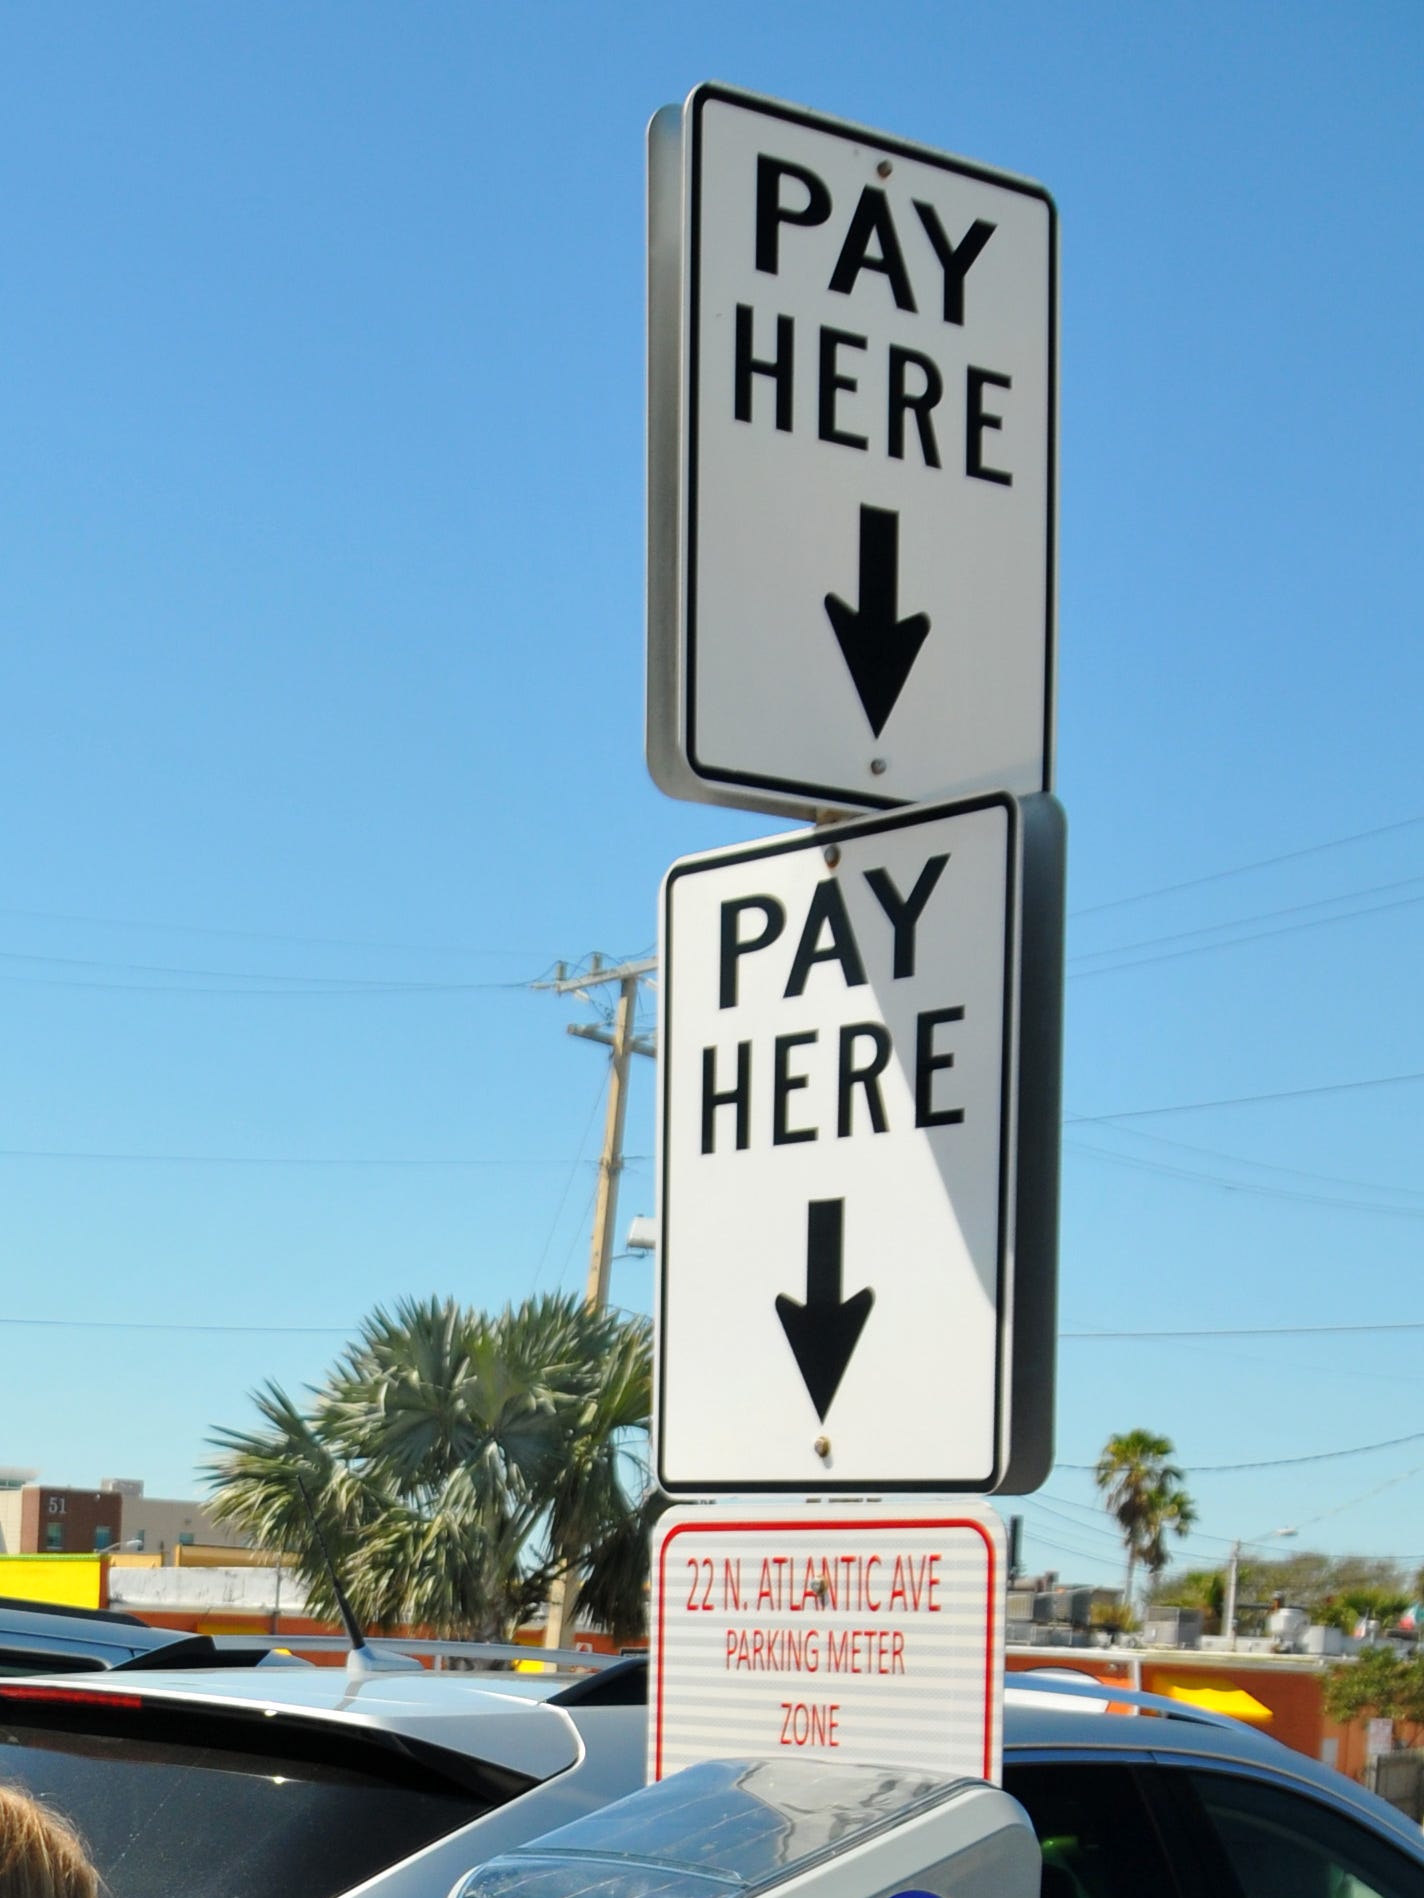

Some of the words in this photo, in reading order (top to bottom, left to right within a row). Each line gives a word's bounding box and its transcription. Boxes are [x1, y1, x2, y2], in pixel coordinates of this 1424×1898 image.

[755, 151, 998, 327] PAY
[733, 303, 1014, 487] HERE
[718, 852, 952, 1010] PAY
[700, 1004, 966, 1155] HERE
[48, 1496, 66, 1514] 51
[686, 1557, 715, 1612] 22
[724, 1557, 749, 1612] N.
[757, 1555, 883, 1612] ATLANTIC
[889, 1554, 943, 1613] AVE
[726, 1629, 820, 1674] PARKING
[828, 1630, 906, 1675] METER
[780, 1703, 841, 1748] ZONE
